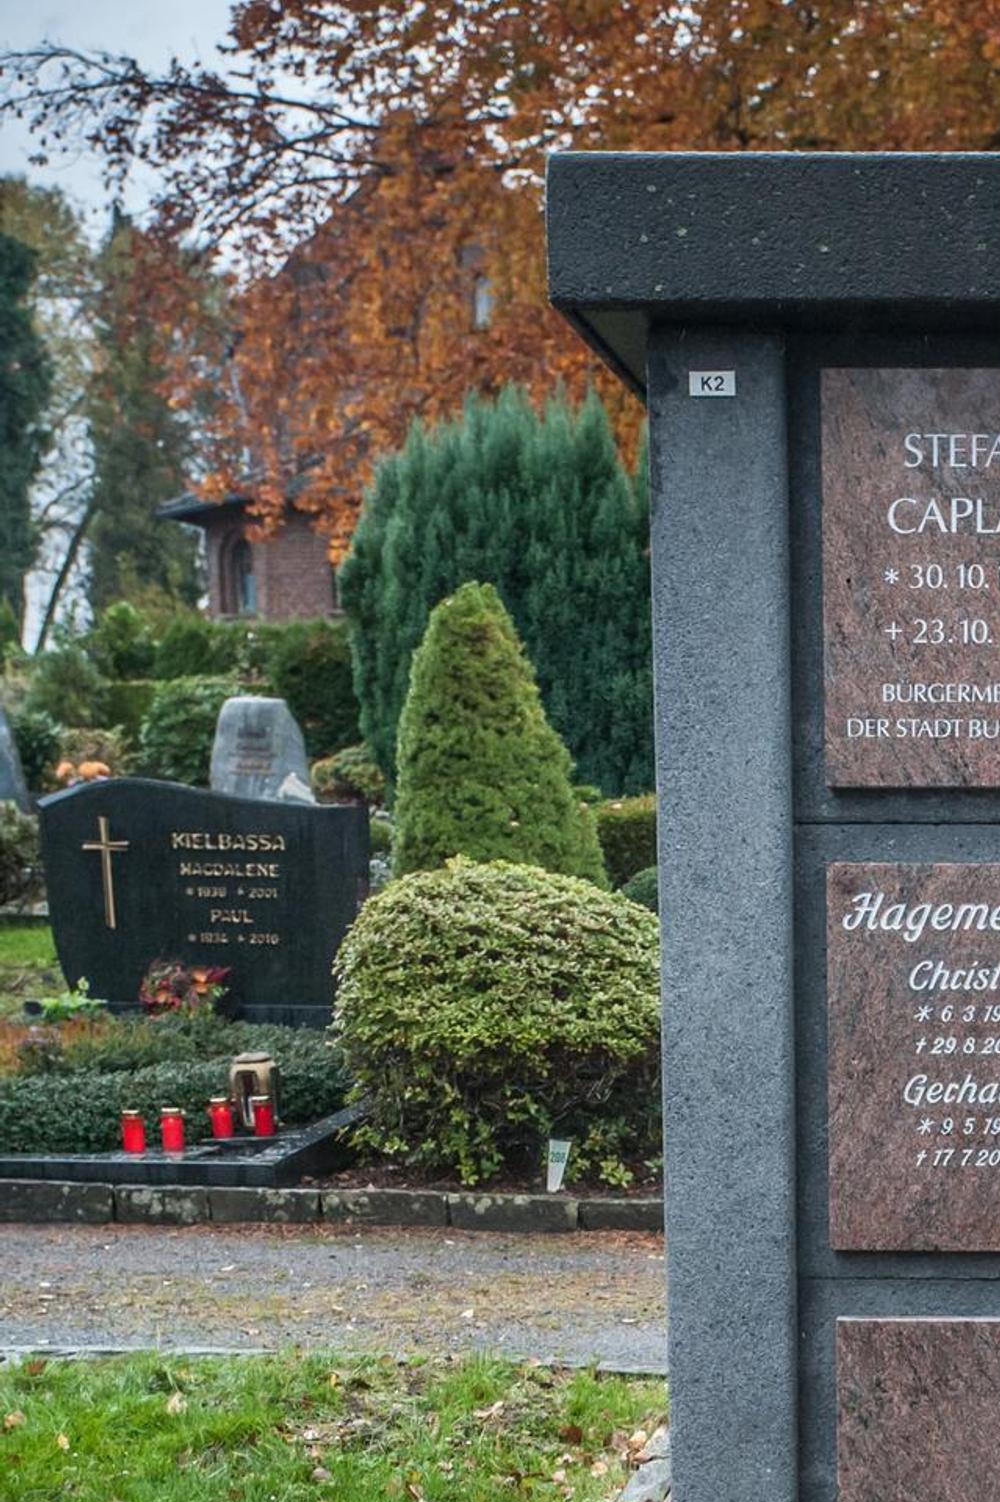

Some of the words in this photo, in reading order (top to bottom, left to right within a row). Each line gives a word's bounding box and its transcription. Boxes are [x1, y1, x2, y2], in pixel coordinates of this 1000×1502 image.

[700, 376, 726, 392] K2
[847, 718, 890, 738] DER
[896, 718, 963, 738] STADT
[172, 832, 286, 851] KIELBASSA
[210, 908, 254, 923] PAUL
